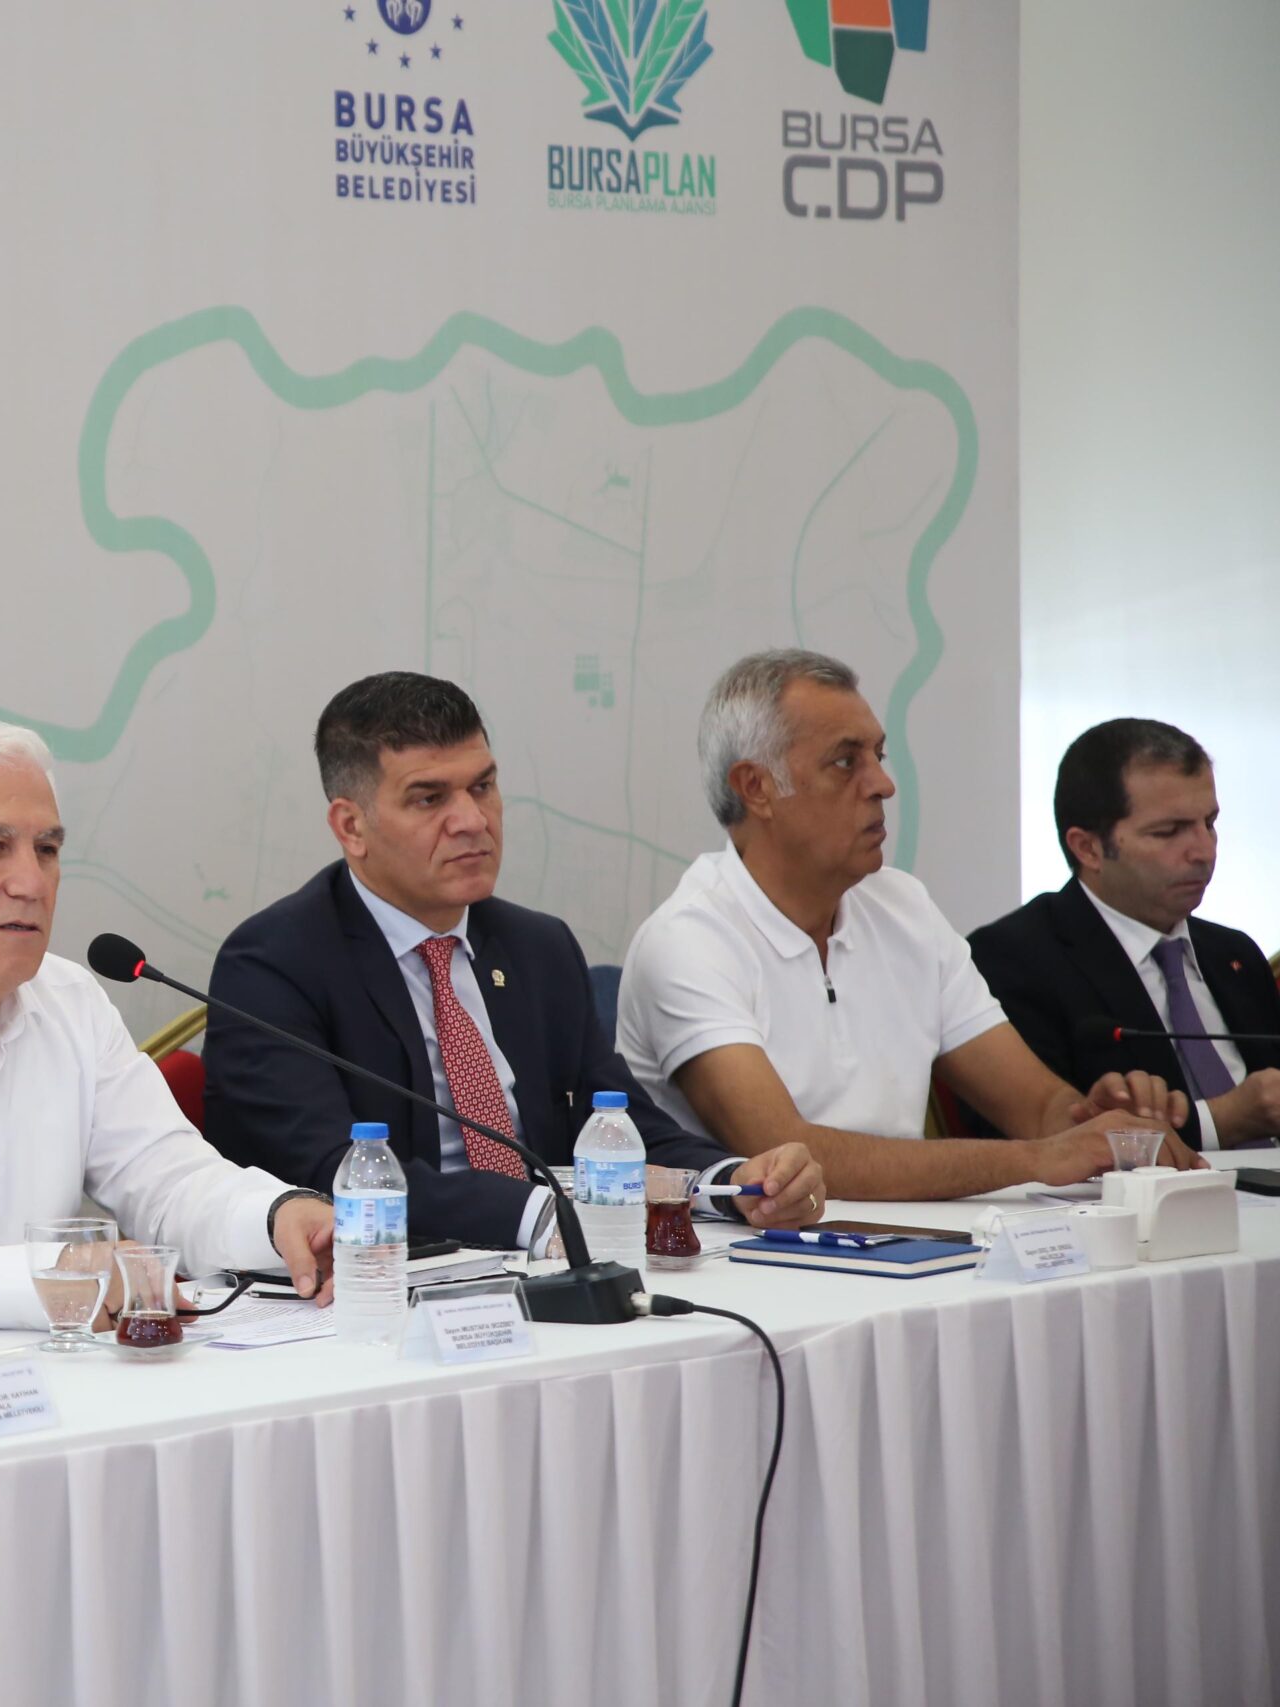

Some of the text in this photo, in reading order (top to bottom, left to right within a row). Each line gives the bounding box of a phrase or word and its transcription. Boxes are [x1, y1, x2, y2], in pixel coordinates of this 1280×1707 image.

[335, 90, 474, 135] BURSA
[782, 110, 943, 156] BURSA
[335, 133, 475, 172] BÜYÜKŞEHİR
[548, 144, 716, 198] BURSAPLAN
[336, 172, 476, 205] BELEDİYESİ
[548, 193, 592, 209] BURSA
[596, 195, 666, 214] PLANLAMA
